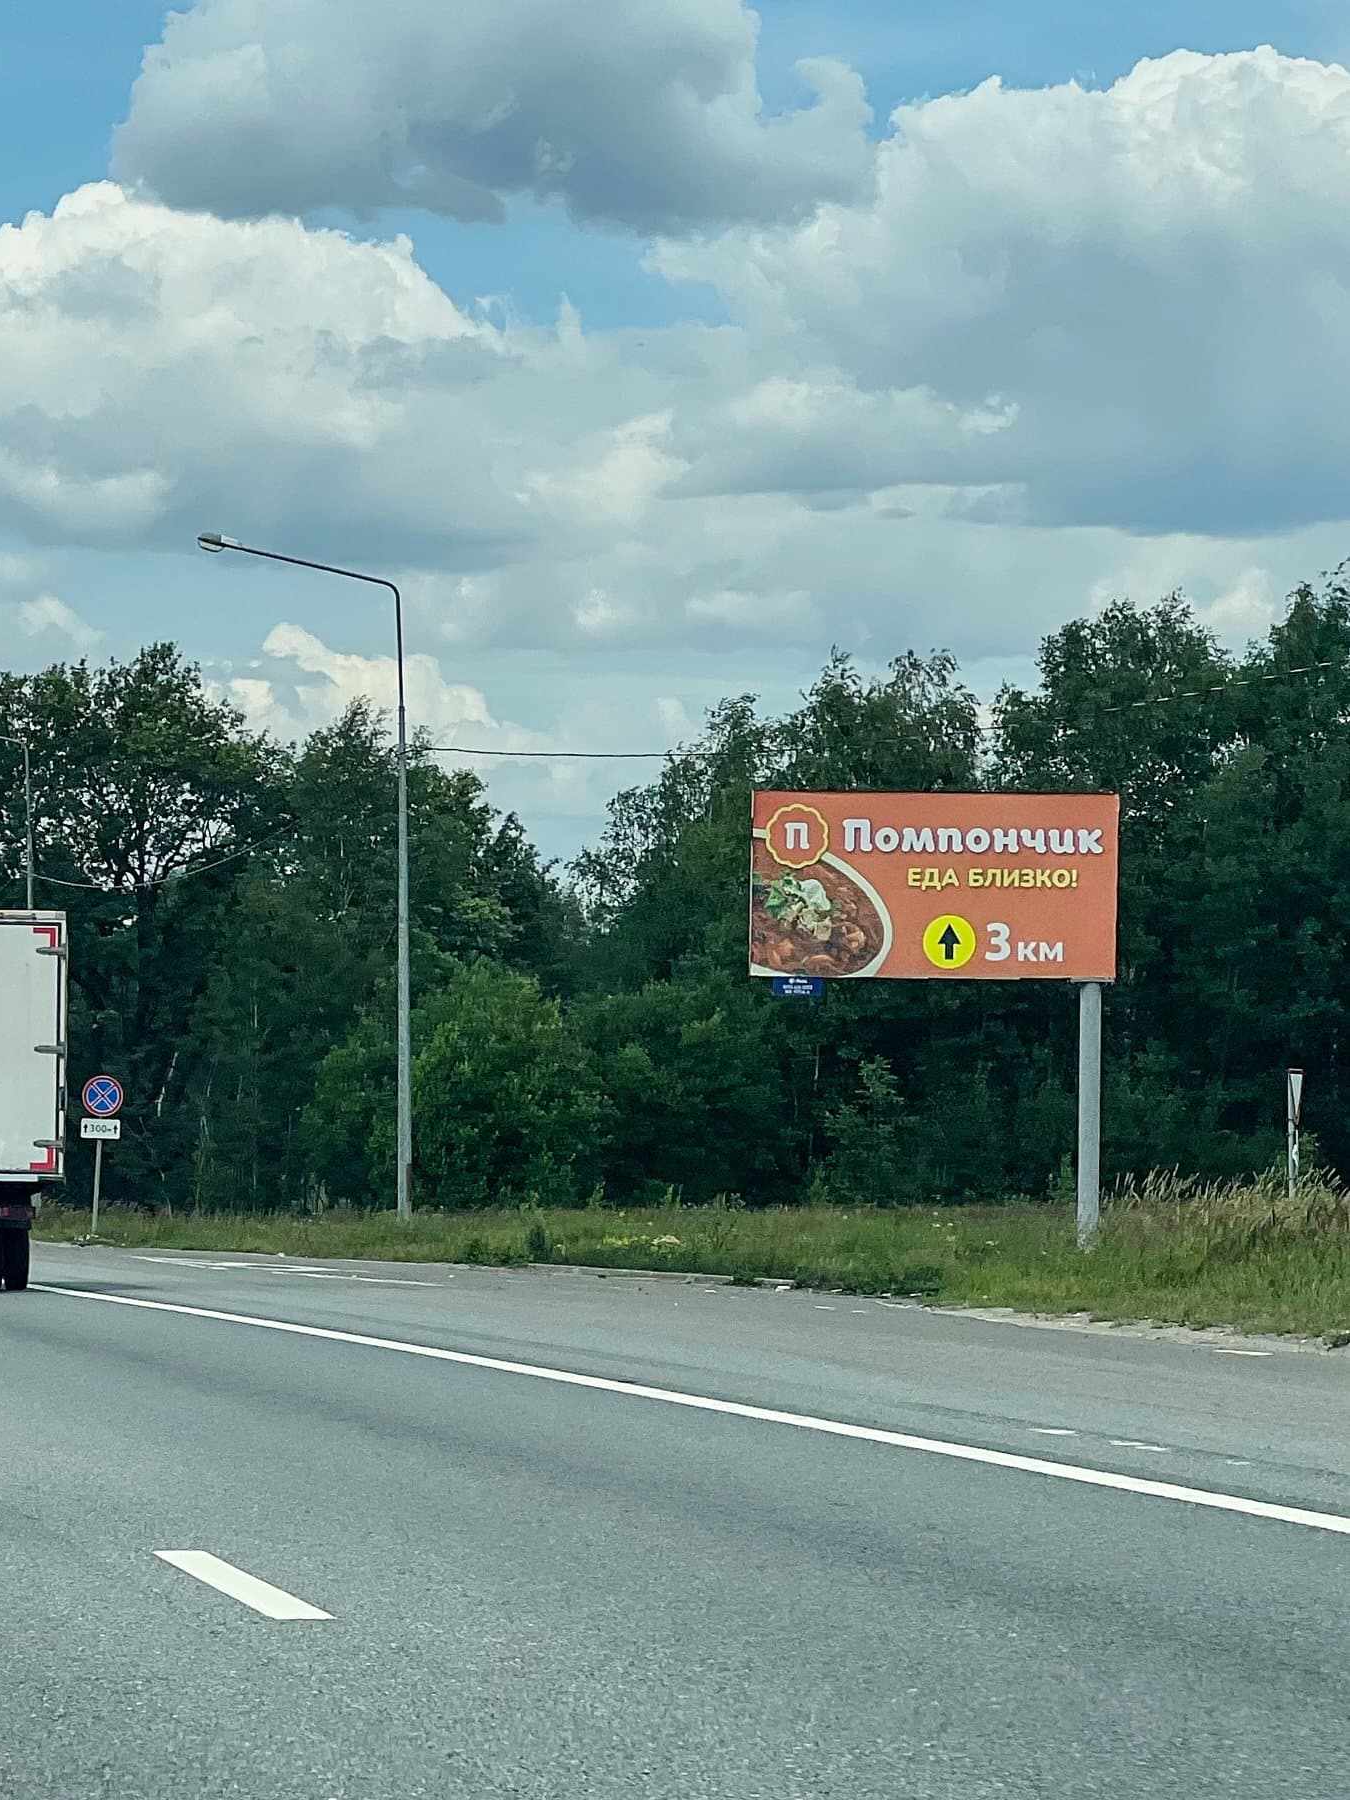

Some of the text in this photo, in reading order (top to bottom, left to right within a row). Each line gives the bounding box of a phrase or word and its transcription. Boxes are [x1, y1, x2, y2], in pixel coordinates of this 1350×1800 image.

[784, 821, 810, 849] П
[842, 818, 1105, 854] Помпончик
[906, 867, 1079, 891] ЕДА БЛИЗКО!
[984, 922, 1012, 962] 3
